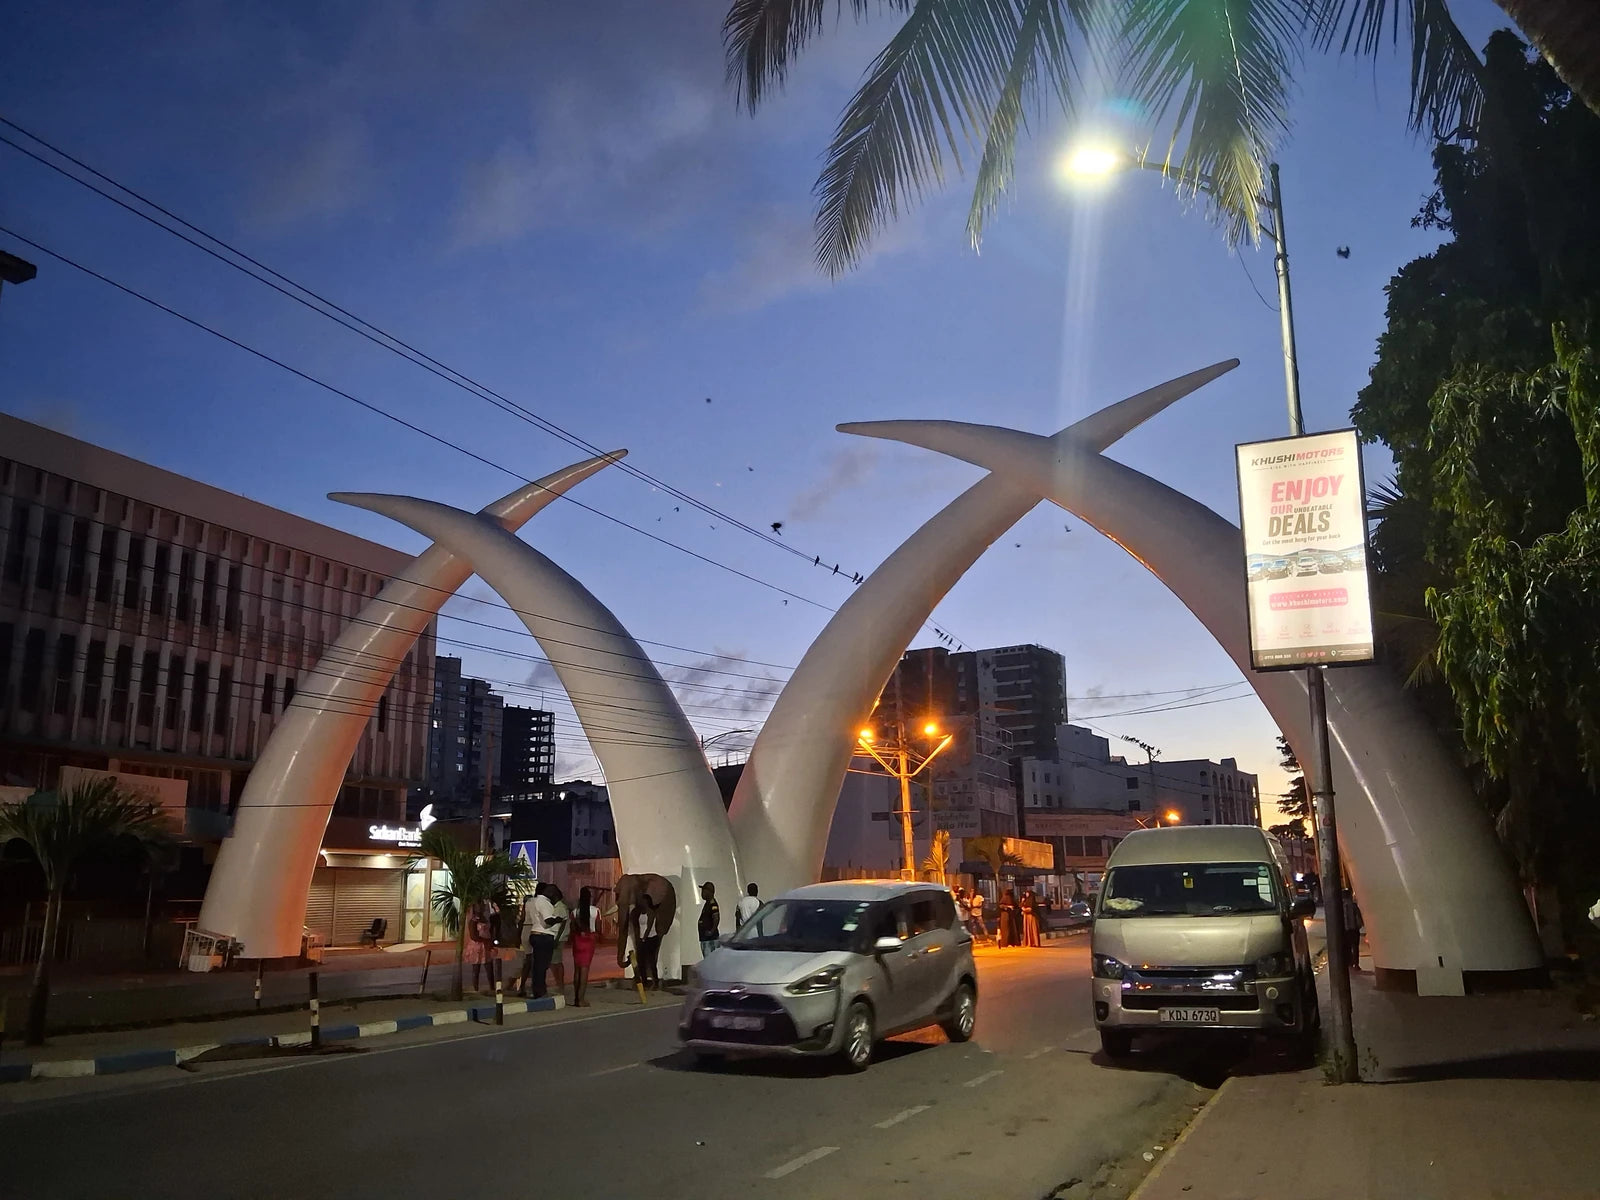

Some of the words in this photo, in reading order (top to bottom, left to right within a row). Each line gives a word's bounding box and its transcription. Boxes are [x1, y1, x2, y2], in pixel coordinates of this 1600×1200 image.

[1272, 475, 1344, 504] ENJOY
[1270, 504, 1293, 515] OUR
[1269, 511, 1330, 537] DEALS
[1169, 1009, 1188, 1021] KDJ
